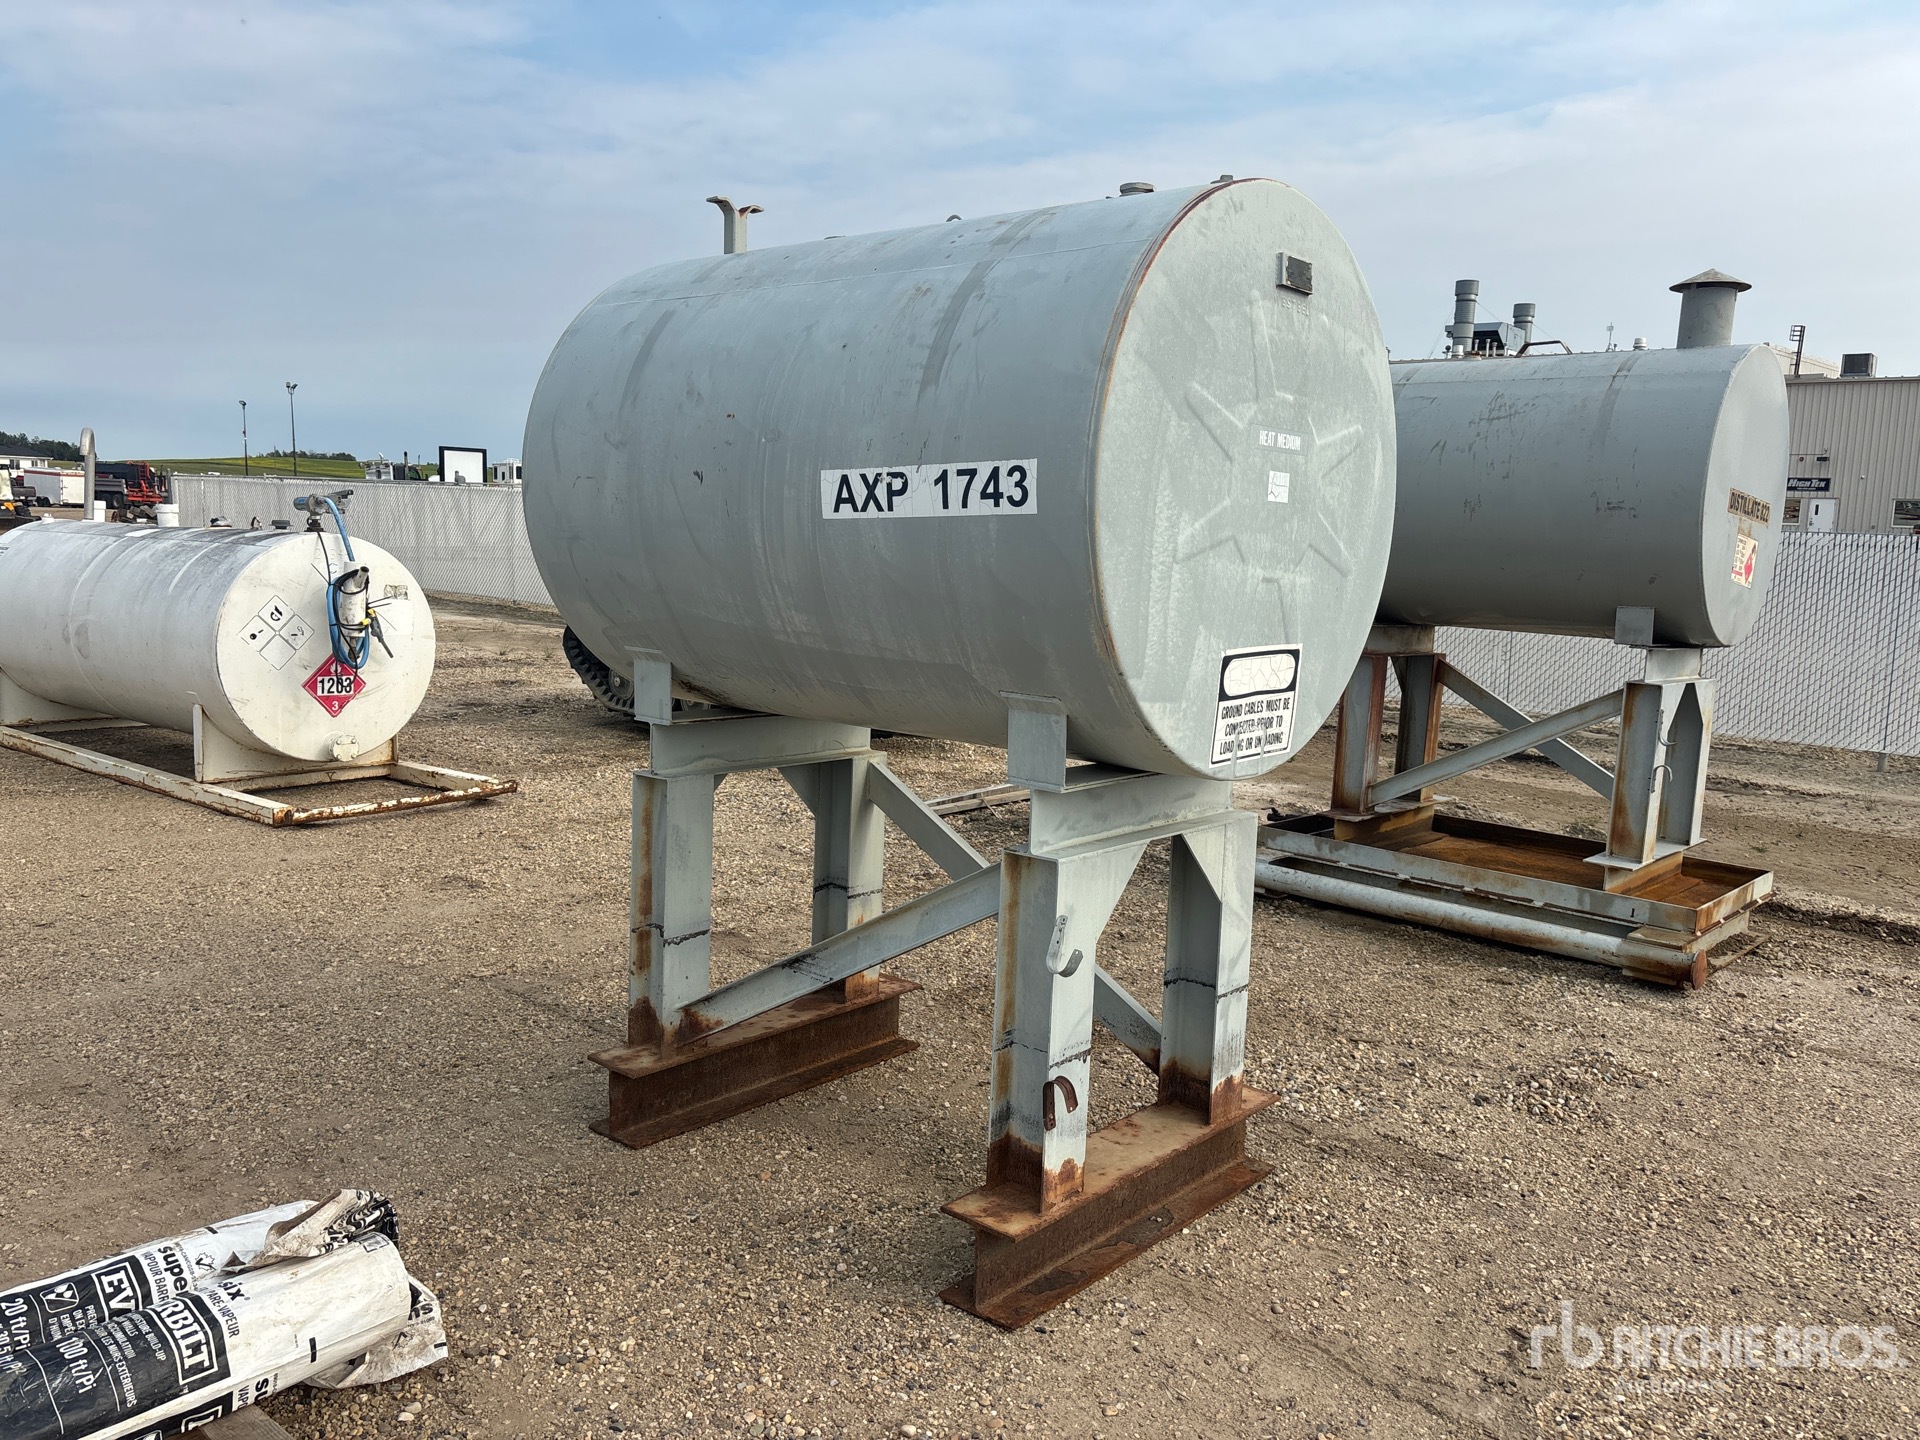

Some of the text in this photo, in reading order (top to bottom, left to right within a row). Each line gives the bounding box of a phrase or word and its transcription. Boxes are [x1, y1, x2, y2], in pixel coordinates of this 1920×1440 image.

[1259, 430, 1301, 451] HEAT MEDIUM
[833, 465, 1029, 513] AXP 1743
[1729, 491, 1761, 520] DISTILLATE
[318, 677, 353, 695] 1203
[331, 701, 339, 711] 3
[1221, 697, 1290, 720] GROUND CABLES MUST BE
[1275, 715, 1283, 728] TO
[1245, 737, 1253, 751] OR
[0, 1297, 28, 1317] 20
[55, 1336, 88, 1360] 100
